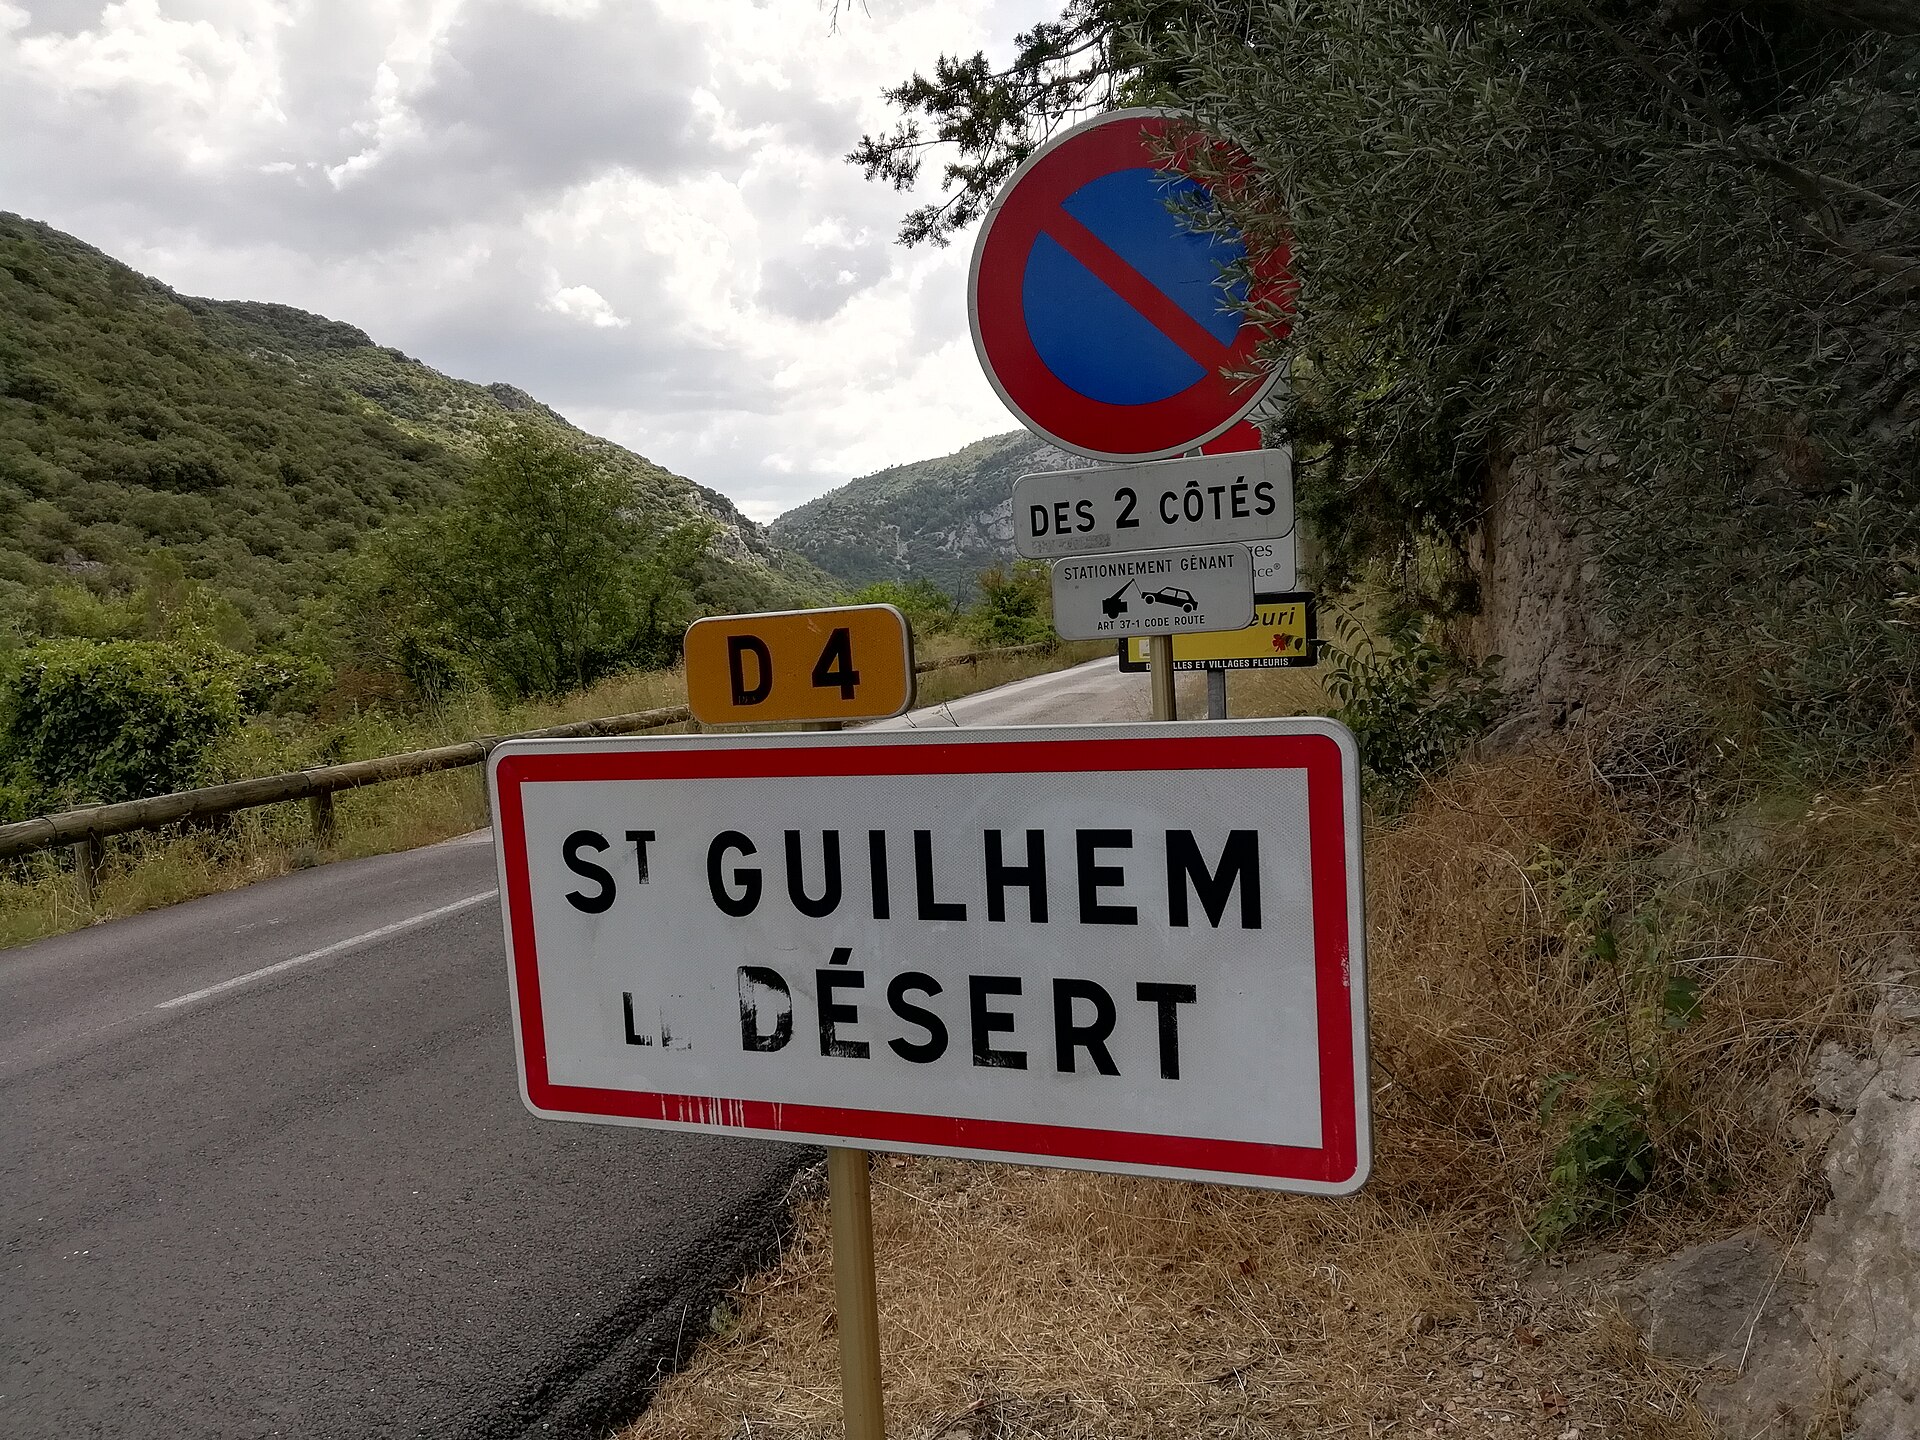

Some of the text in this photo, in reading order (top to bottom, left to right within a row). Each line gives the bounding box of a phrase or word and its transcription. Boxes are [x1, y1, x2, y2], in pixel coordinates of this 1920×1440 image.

[1030, 476, 1276, 537] DES 2 CÔTÉS
[1064, 554, 1235, 580] STATIONNEMENT GÊNANT
[1097, 614, 1206, 631] ART 37-1 CODE ROUTE
[1250, 606, 1295, 626] euri
[727, 627, 860, 706] D 4
[1173, 657, 1289, 670] LLES ET VILLAGES FLEURIS
[707, 829, 1263, 931] GUILHEM
[737, 947, 1198, 1080] DÉSERT
